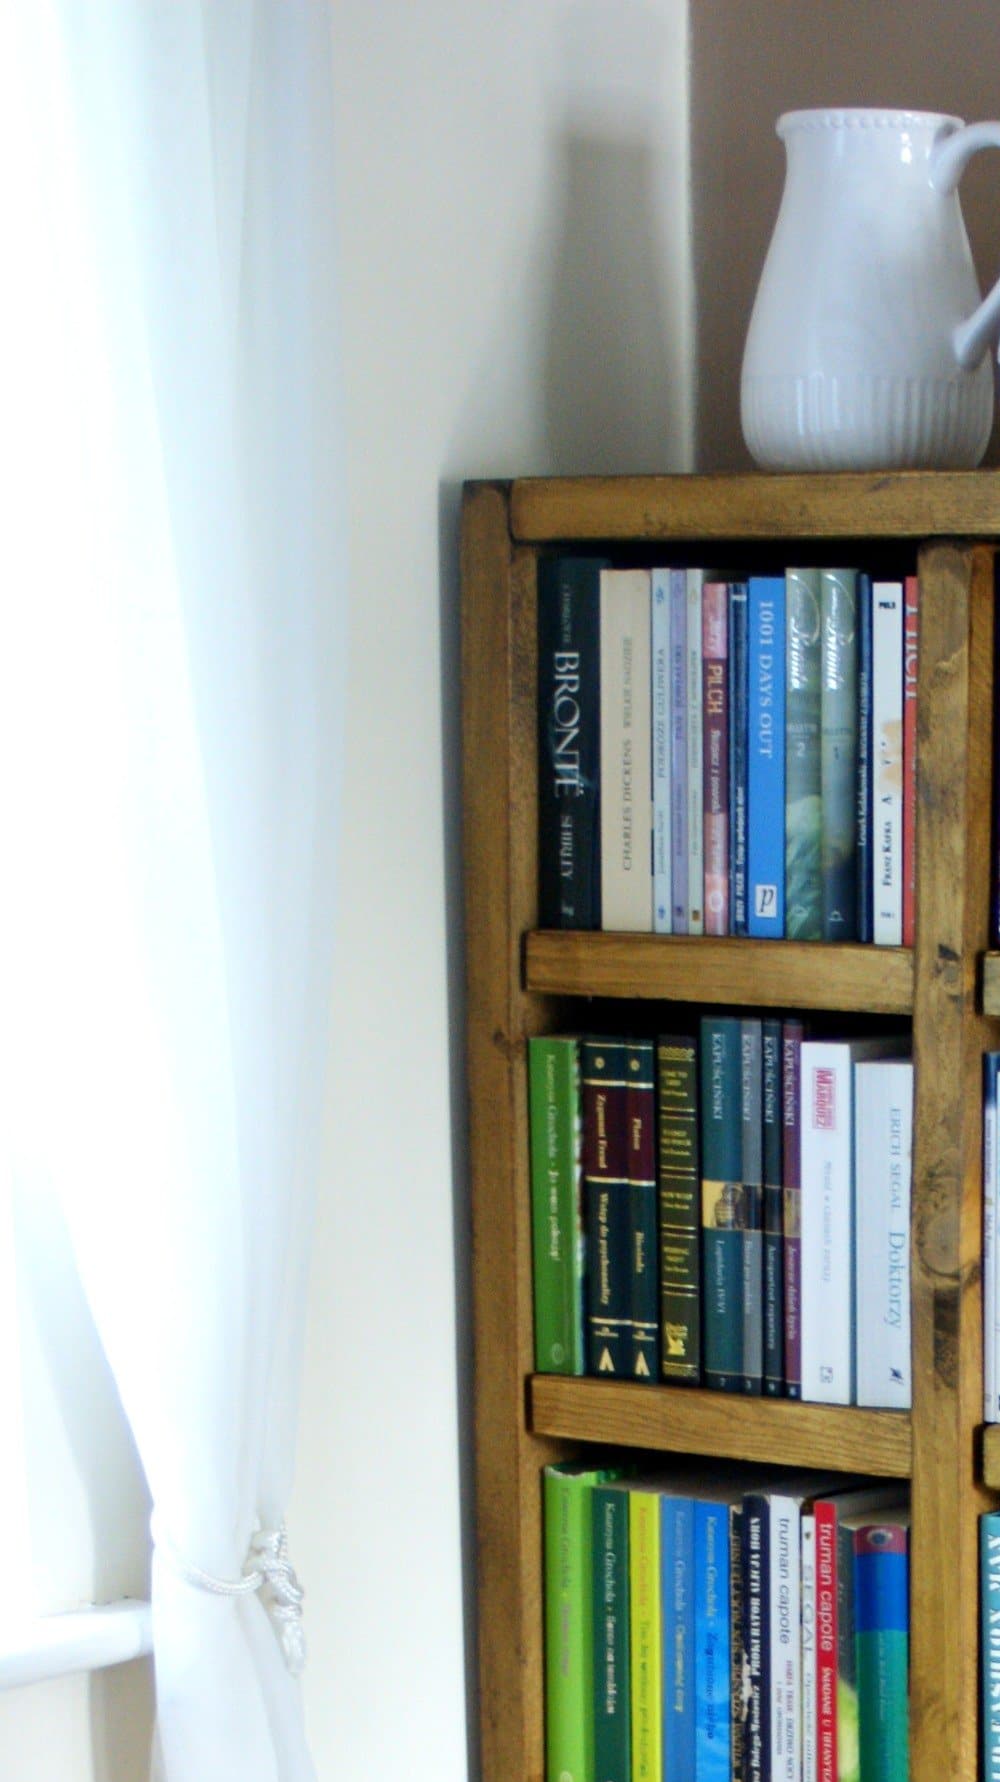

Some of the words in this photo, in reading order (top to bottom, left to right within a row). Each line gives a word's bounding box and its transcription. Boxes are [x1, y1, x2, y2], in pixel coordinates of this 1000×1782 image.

[760, 600, 774, 645] 1001
[707, 665, 722, 713] PILCH
[760, 654, 774, 707] DAYS
[553, 651, 584, 798] BRONTË
[760, 713, 774, 758] OUT
[622, 739, 632, 801] DICKENS
[622, 807, 632, 871] CHARLES
[884, 1232, 905, 1329] Doktorzy
[777, 1517, 792, 1581] truman
[819, 1524, 834, 1586] truman
[777, 1585, 792, 1644] capote
[818, 1591, 834, 1651] capote
